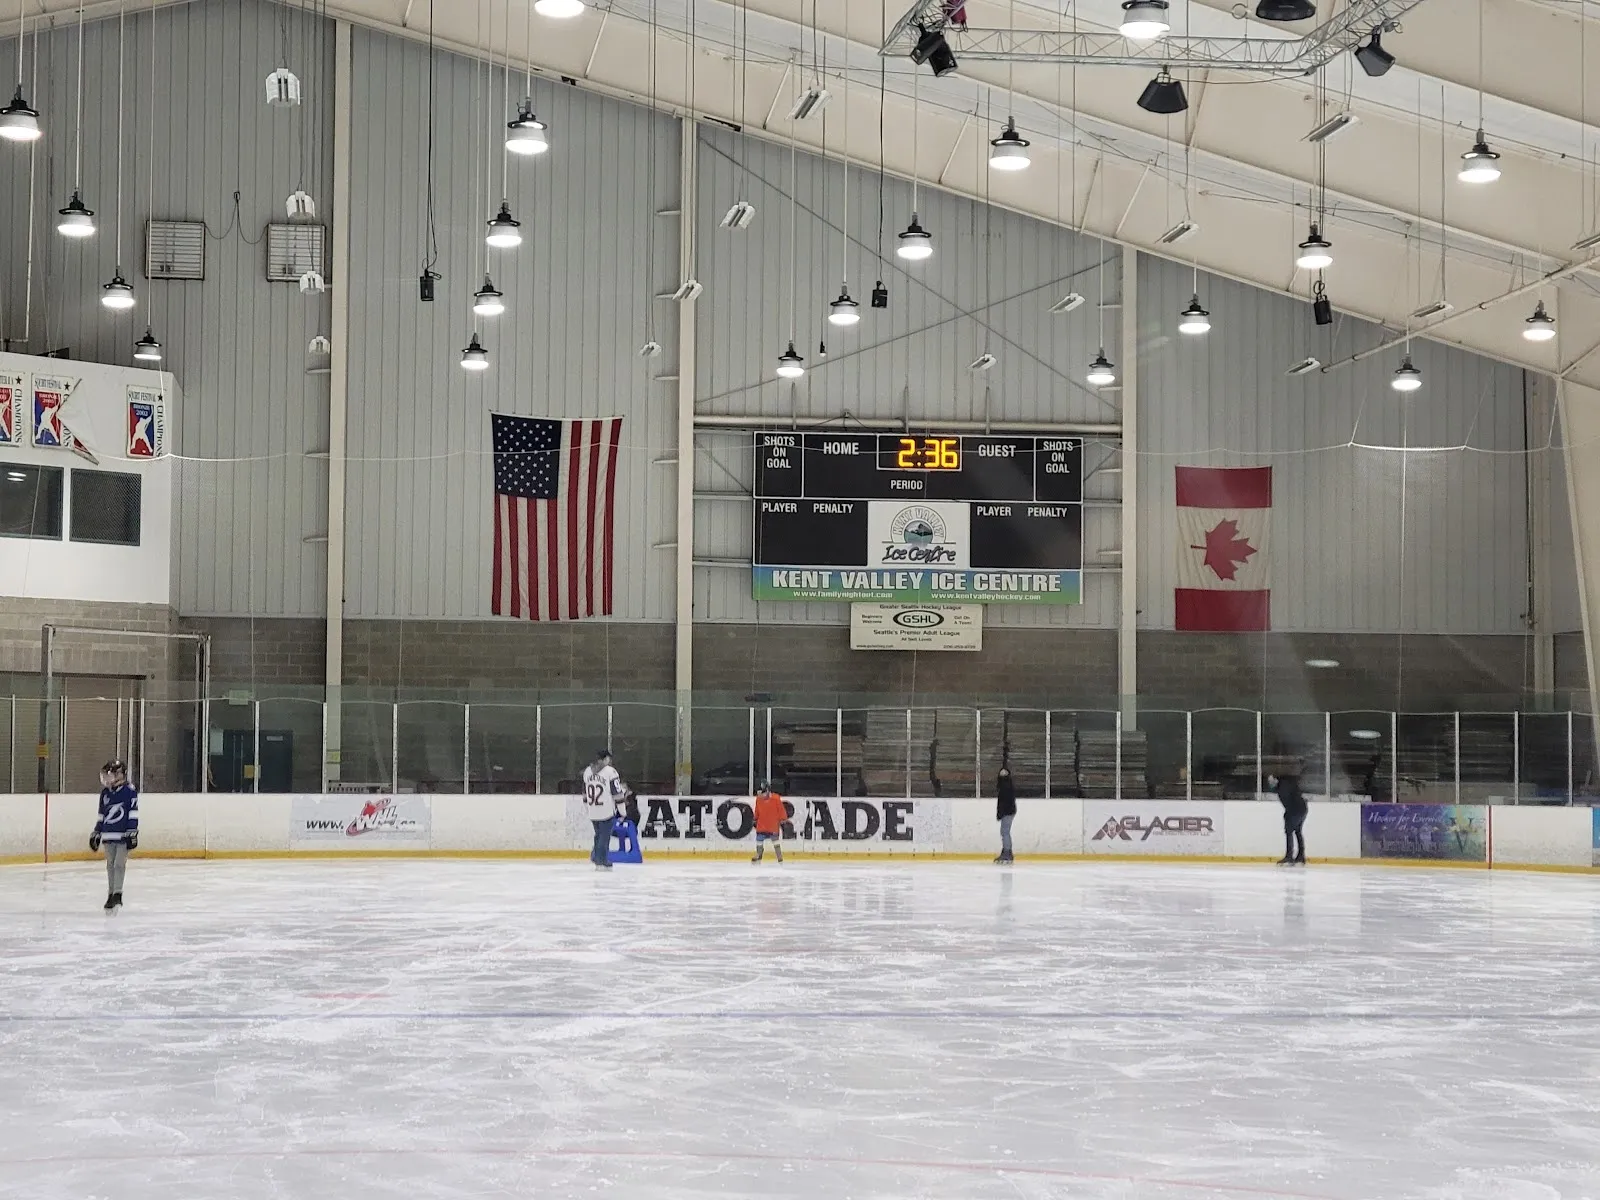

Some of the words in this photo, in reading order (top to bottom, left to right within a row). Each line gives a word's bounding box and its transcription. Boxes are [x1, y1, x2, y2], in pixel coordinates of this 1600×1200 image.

[764, 436, 795, 446] SHOTS
[1043, 441, 1074, 451] SHOTS
[772, 447, 786, 457] ON
[823, 442, 860, 455] HOME
[898, 438, 958, 468] 2:36
[978, 444, 1016, 457] GUEST
[766, 458, 791, 468] GOAL
[1051, 452, 1065, 462] ON
[1045, 463, 1070, 473] GOAL
[890, 479, 923, 490] PERIOD
[762, 502, 797, 513] PLAYER
[813, 503, 853, 514] PENALTY
[976, 505, 1012, 516] PLAYER
[1027, 506, 1067, 517] PENALTY
[882, 545, 907, 561] Ice
[908, 545, 956, 563] Centre
[772, 570, 833, 589] KENT
[840, 571, 924, 590] VALLEY
[931, 572, 967, 591] ICE
[973, 573, 1062, 592] CENTRE
[902, 615, 936, 624] GSHL
[588, 784, 604, 806] 92
[641, 798, 915, 842] ATORADE
[1119, 816, 1214, 841] GLACIER
